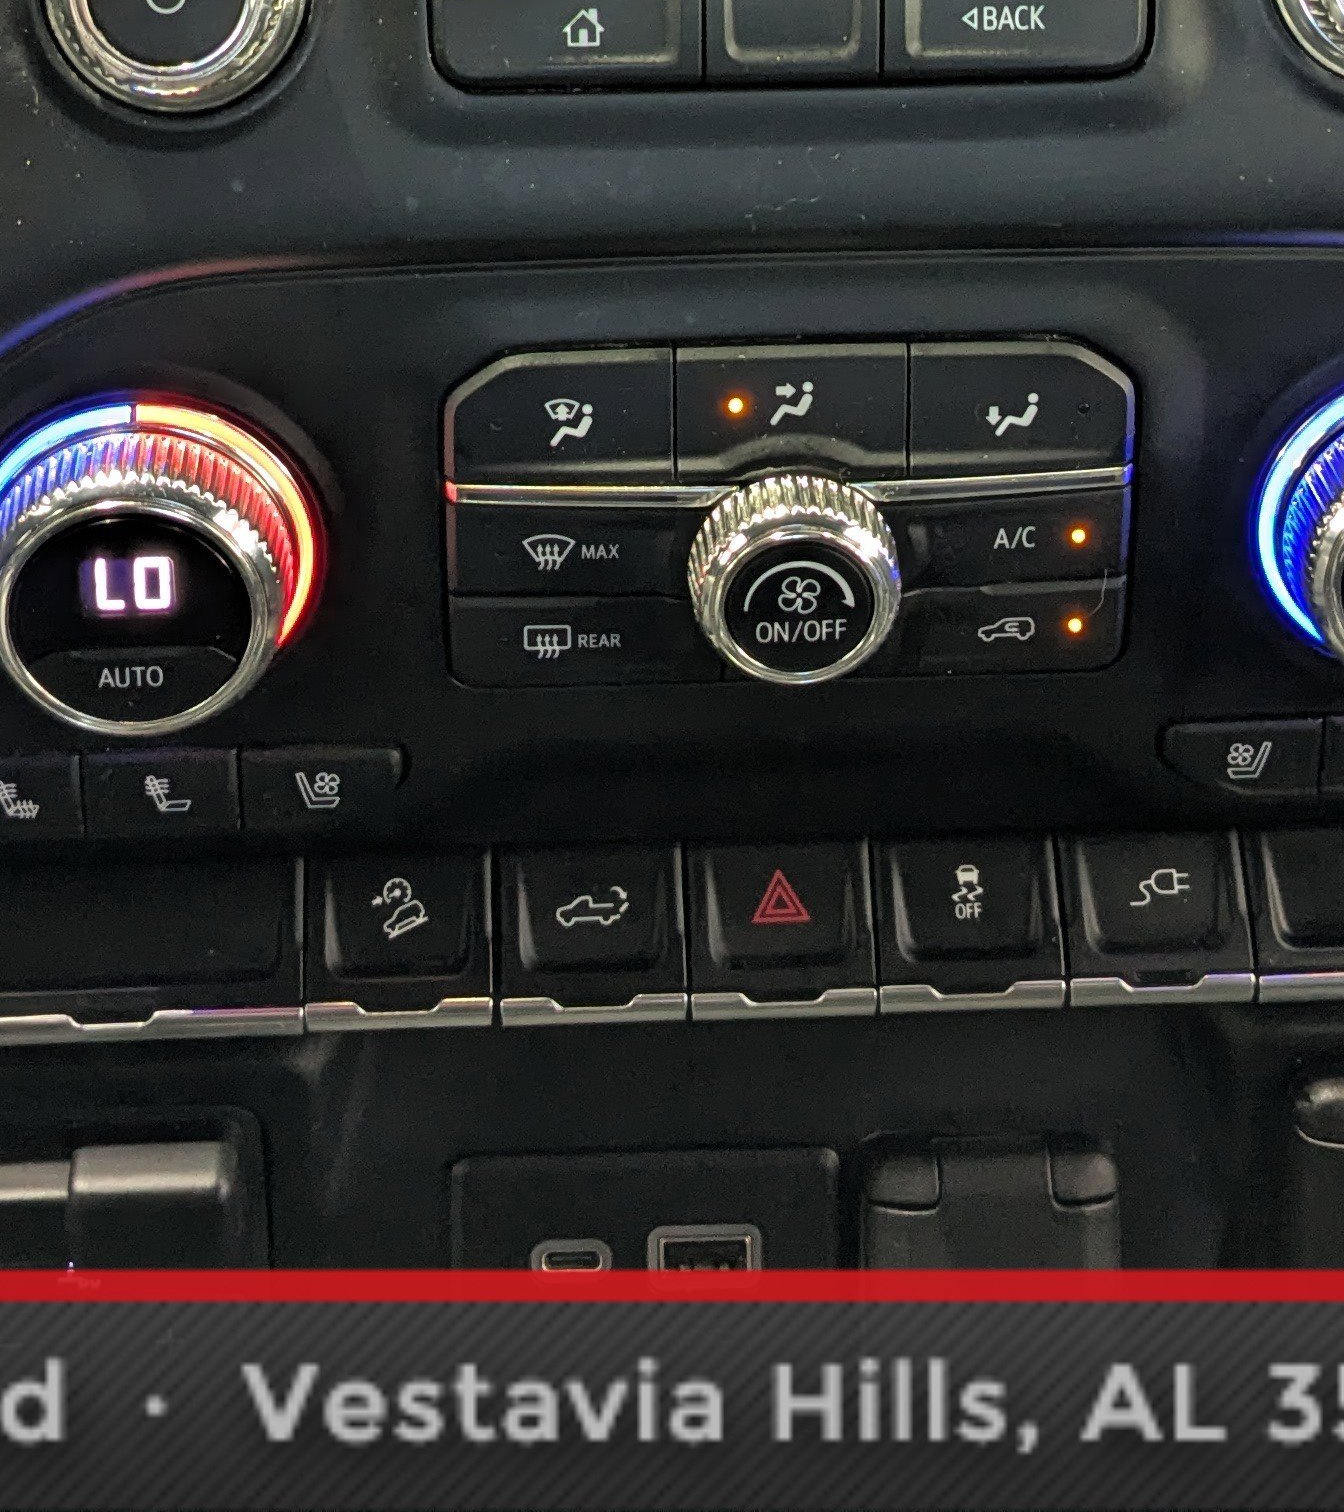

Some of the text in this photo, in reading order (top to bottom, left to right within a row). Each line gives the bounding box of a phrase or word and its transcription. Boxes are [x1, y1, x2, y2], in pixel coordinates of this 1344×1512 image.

[982, 4, 1046, 32] BACK
[993, 525, 1036, 550] A/C
[581, 543, 620, 560] MAX
[94, 556, 174, 611] LO
[577, 633, 621, 648] REAR
[755, 618, 847, 643] ON/OFF
[98, 665, 164, 689] AUTO
[955, 901, 982, 920] OFF
